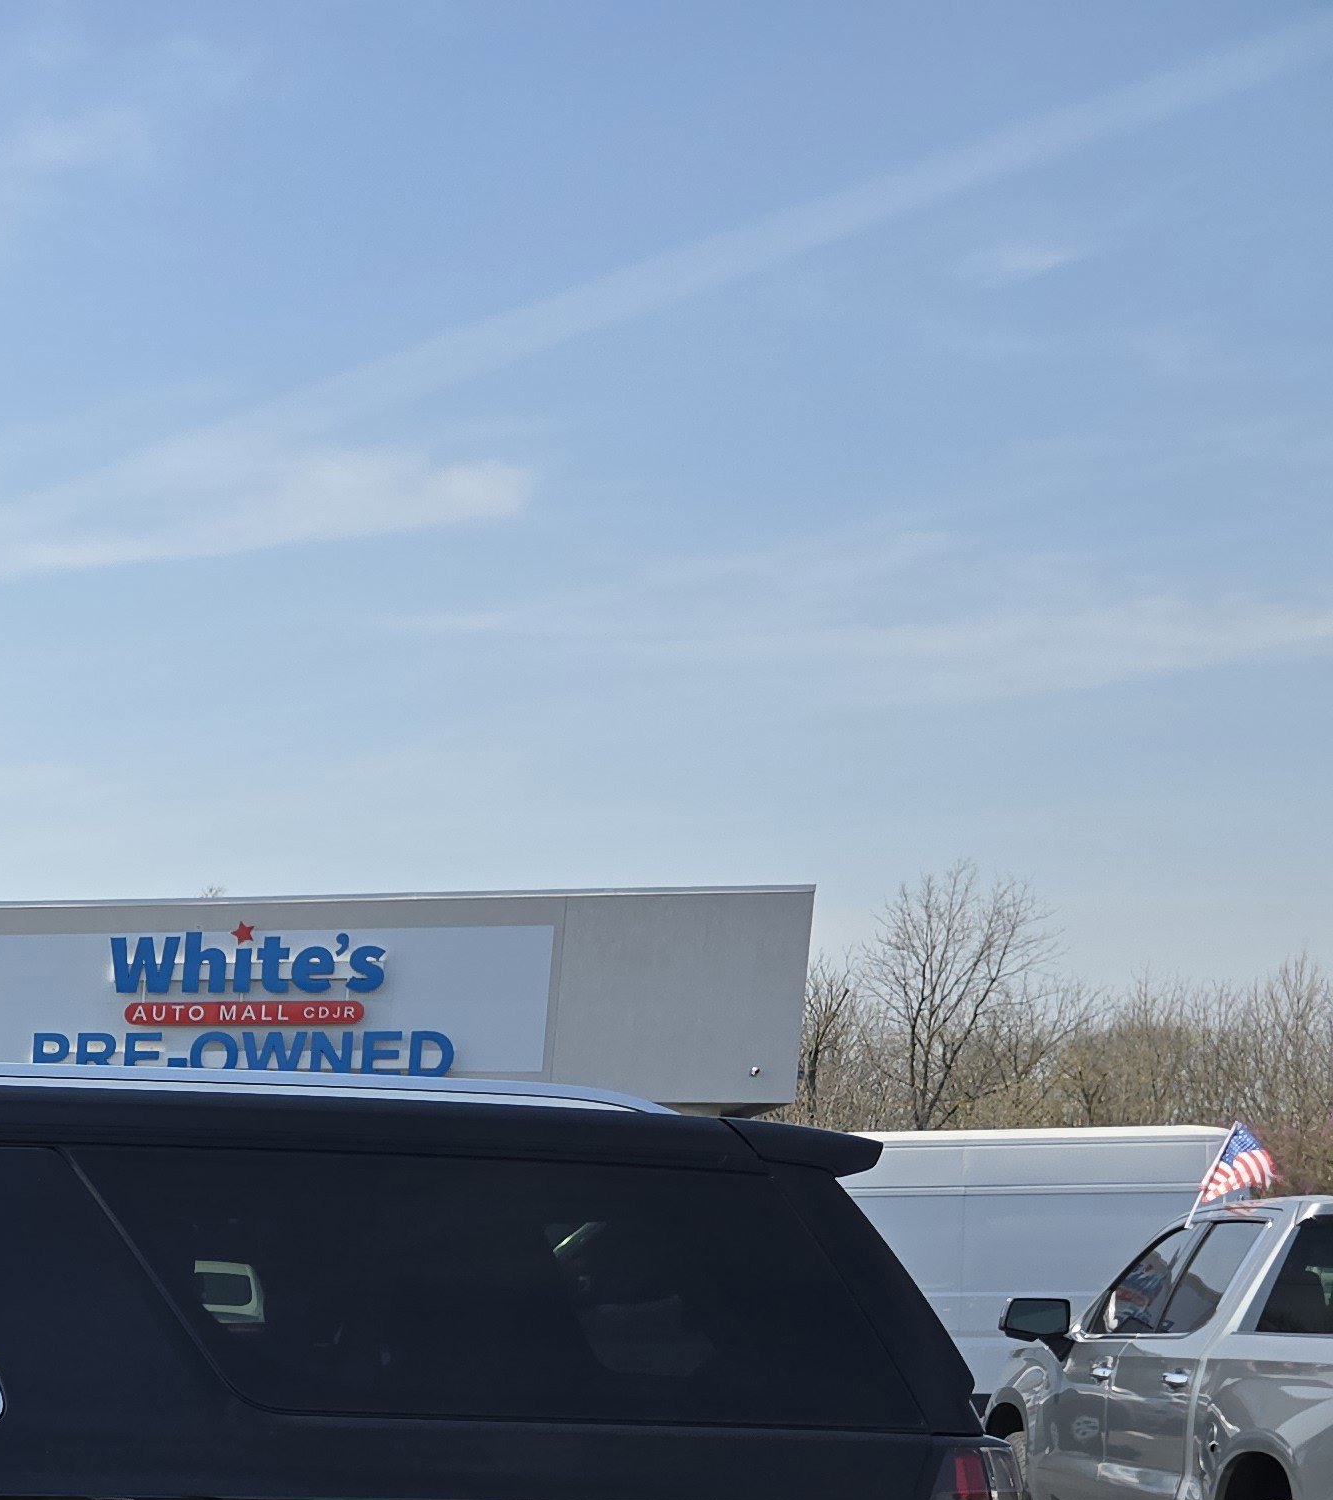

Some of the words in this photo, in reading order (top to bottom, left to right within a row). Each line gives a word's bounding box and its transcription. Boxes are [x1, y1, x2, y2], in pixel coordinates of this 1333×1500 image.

[110, 922, 386, 993] White's
[132, 1004, 205, 1022] AUTO
[219, 1004, 289, 1022] MALL
[303, 1006, 356, 1019] CDJR
[32, 1030, 455, 1077] PRE-OWNED
